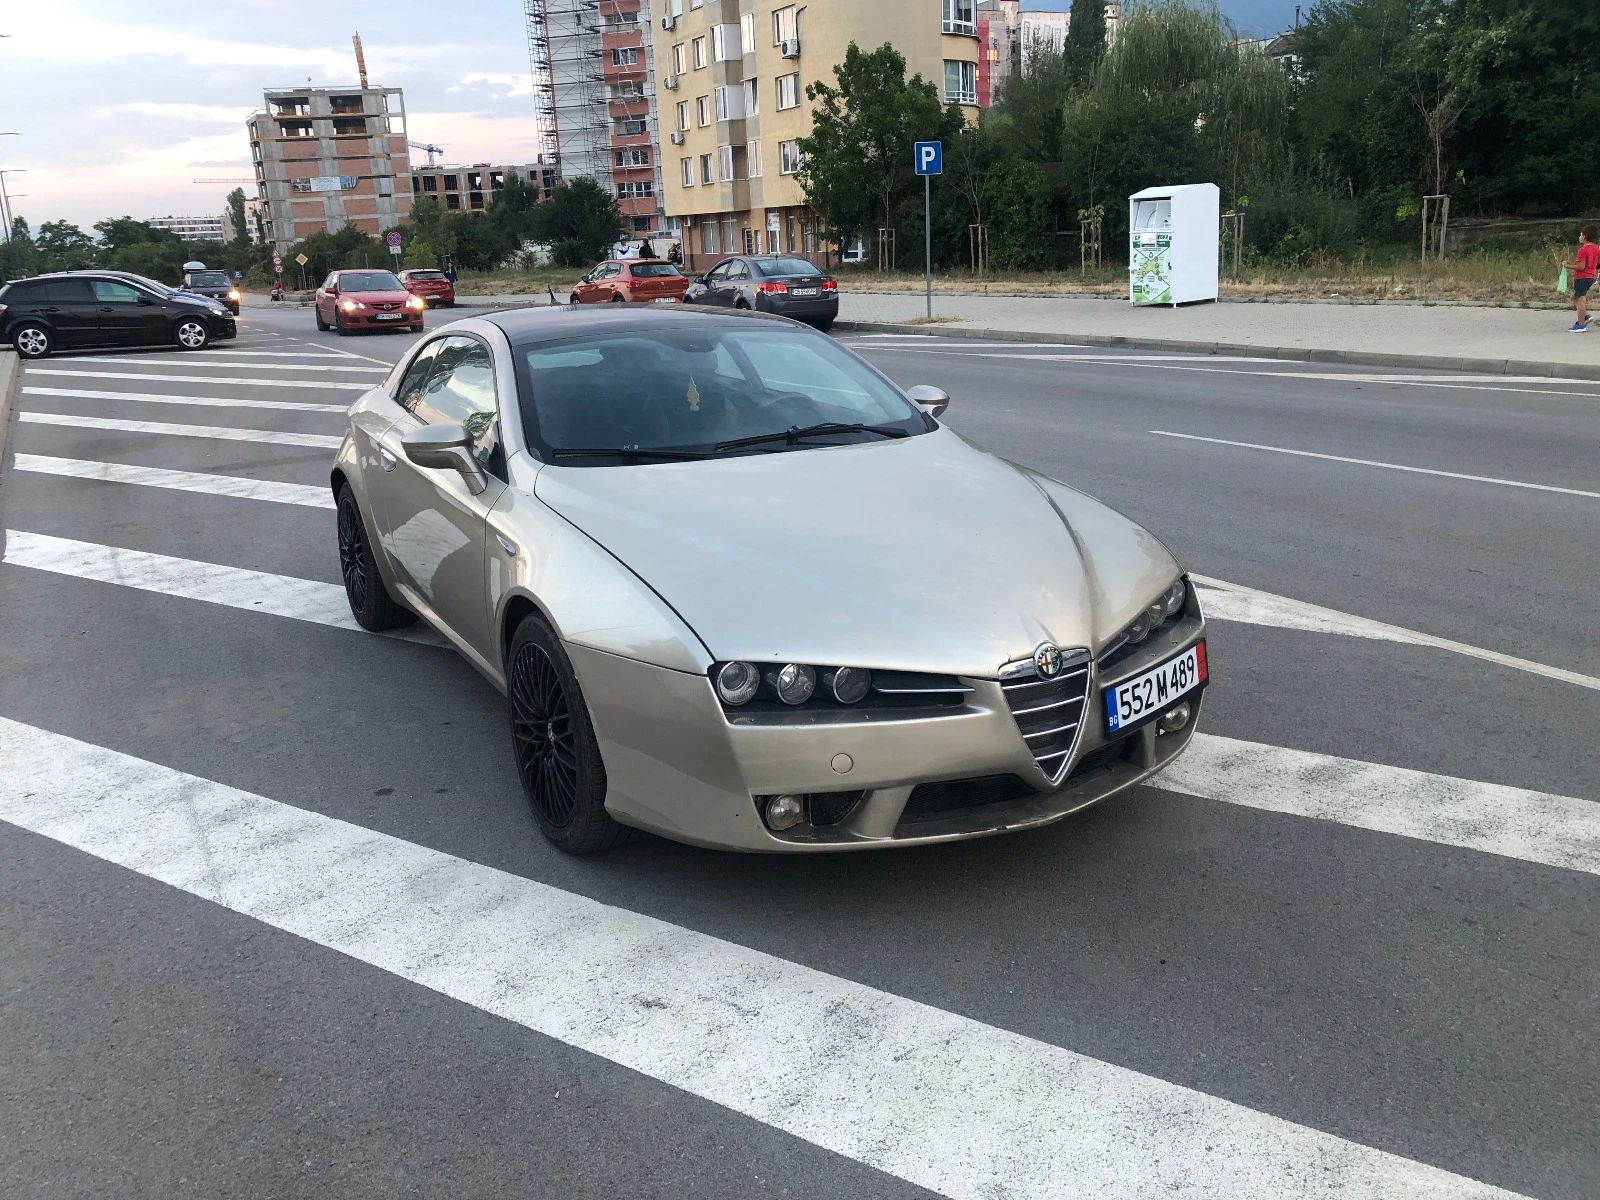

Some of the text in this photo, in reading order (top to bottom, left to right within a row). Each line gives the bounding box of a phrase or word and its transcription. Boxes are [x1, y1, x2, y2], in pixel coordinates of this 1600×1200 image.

[922, 146, 935, 170] P
[1120, 654, 1195, 720] 552 M 489
[1109, 714, 1118, 727] BG
